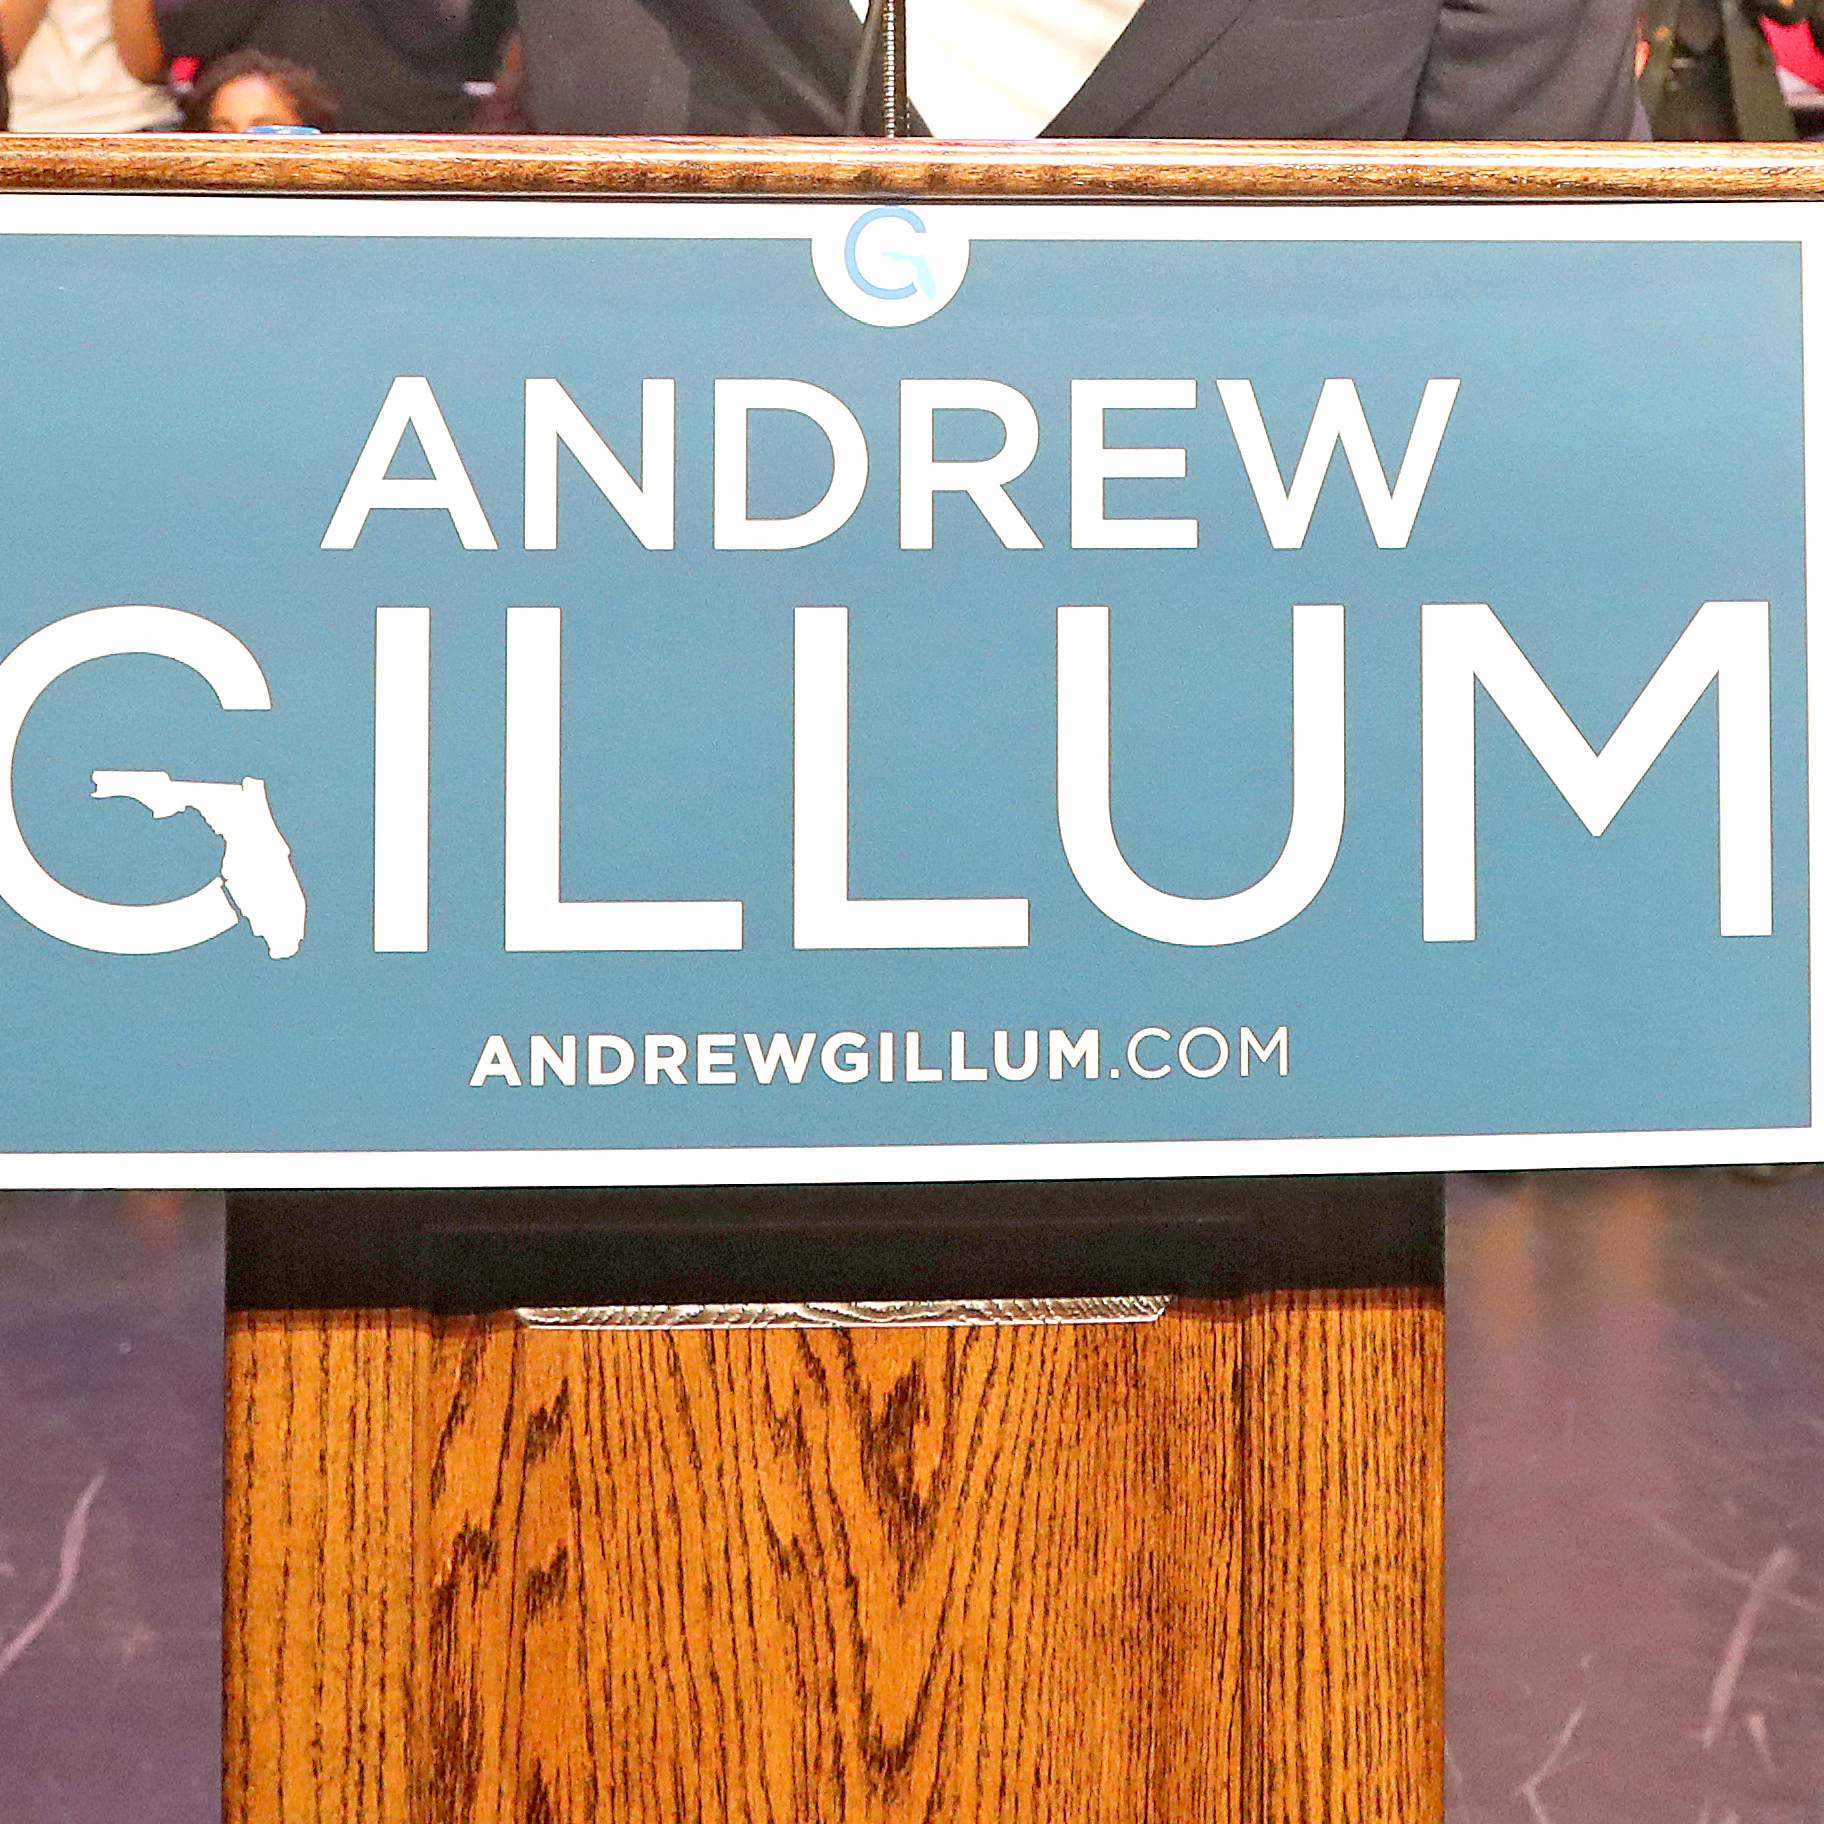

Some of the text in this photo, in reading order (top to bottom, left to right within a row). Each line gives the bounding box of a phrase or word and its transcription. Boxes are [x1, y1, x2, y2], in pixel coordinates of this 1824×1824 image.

[844, 205, 937, 301] G
[320, 376, 1461, 550] ANDREW
[469, 1025, 1289, 1088] ANDREWGILLUM.COM
